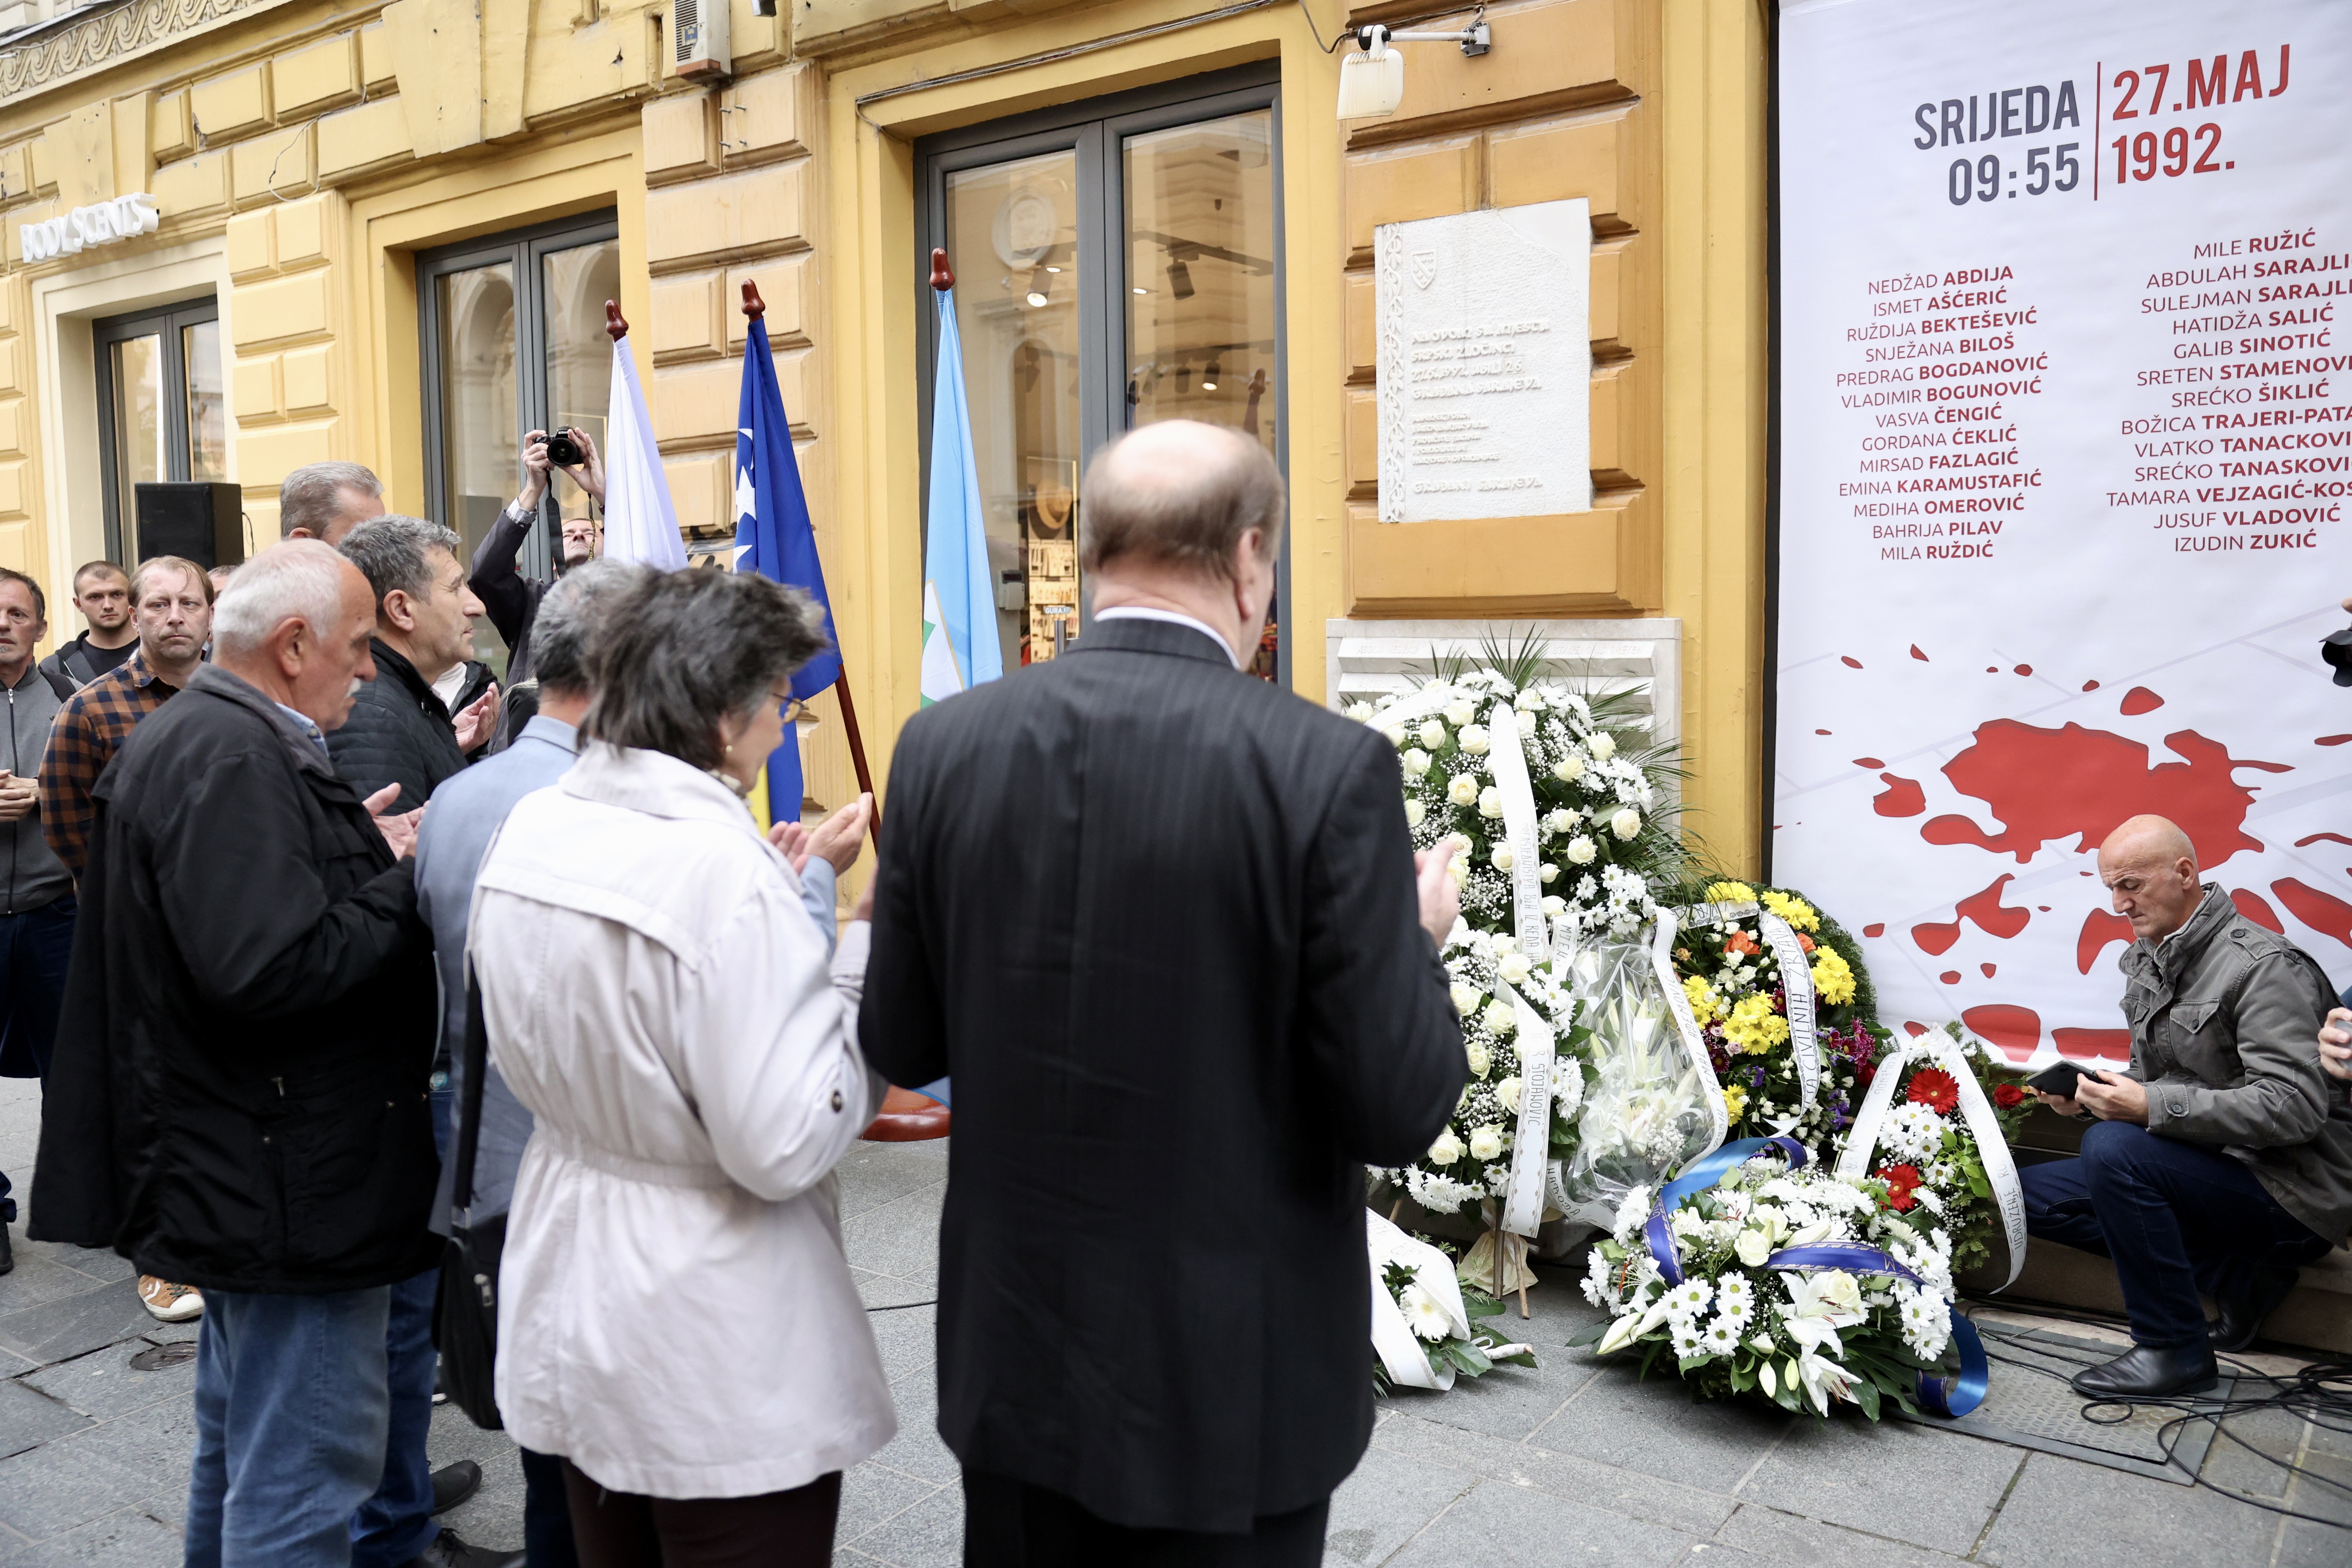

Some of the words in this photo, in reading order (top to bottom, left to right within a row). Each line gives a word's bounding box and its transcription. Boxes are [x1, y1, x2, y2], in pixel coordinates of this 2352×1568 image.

[2112, 43, 2291, 121] 27.MAJ
[1914, 80, 2080, 150] SRIJEDA
[2111, 122, 2236, 184] 1992.
[1948, 142, 2079, 205] 09:55
[2194, 240, 2242, 259] MILE
[2249, 227, 2315, 253] RUŽIĆ
[1868, 273, 1937, 295] NEDŽAD
[1943, 266, 2013, 286] ABDIJA
[2147, 264, 2247, 288] ABDULAH
[2254, 254, 2352, 278] SARAJLI
[1874, 298, 1923, 316] ISMET
[1927, 285, 2006, 310] AŠĆERIĆ
[2141, 289, 2251, 313] SULEJMAN
[1847, 322, 1916, 342] RUŽDIJA
[1922, 306, 2037, 334] BEKTEŠEVIĆ
[2173, 310, 2262, 334] HATIDŽA
[2269, 302, 2334, 327] SALIĆ
[1866, 341, 1954, 362] SNJEŽANA
[1960, 331, 2014, 353] BILOŠ
[2174, 340, 2233, 358] GALIB
[2240, 327, 2331, 353] SINOTIĆ
[1837, 368, 1913, 387] PREDRAG
[1920, 352, 2048, 380] BOGDANOVIĆ
[2137, 367, 2213, 386] SRETEN
[1841, 389, 1921, 408] VLADIMIR
[1927, 375, 2041, 401] BOGUNOVIĆ
[2171, 386, 2251, 407] SREĆKO
[2259, 378, 2329, 402] ŠIKLIĆ
[1876, 412, 1929, 428] VASVA
[1935, 402, 2002, 423] ČENGIĆ
[2122, 415, 2196, 435] BOŽICA
[1862, 433, 1947, 451] GORDANA
[1953, 424, 2017, 445] ĆEKLIĆ
[2135, 440, 2214, 458] VLATKO
[2220, 431, 2351, 453] TANACKOVI
[1860, 457, 1923, 473] MIRSAD
[1929, 447, 2018, 469] FAZLAGIĆ
[2135, 461, 2213, 482] SREĆKO
[2220, 457, 2352, 477] TANASKOVI
[1839, 481, 1892, 496] EMINA
[1897, 468, 2041, 493] KARAMUSTAFIĆ
[1854, 502, 1919, 518] MEDIHA
[1925, 493, 2024, 514] OMEROVIĆ
[2107, 490, 2190, 506] TAMARA
[2154, 512, 2217, 529] JUSUF
[2223, 502, 2341, 526] VLADOVIĆ
[1873, 524, 1943, 539] BAHRIJA
[1949, 521, 2003, 536] PILAV
[2175, 536, 2243, 551] IZUDIN
[2250, 528, 2317, 550] ZUKIĆ
[1881, 546, 1921, 560] MILA
[1927, 539, 1993, 559] RUŽDIĆ
